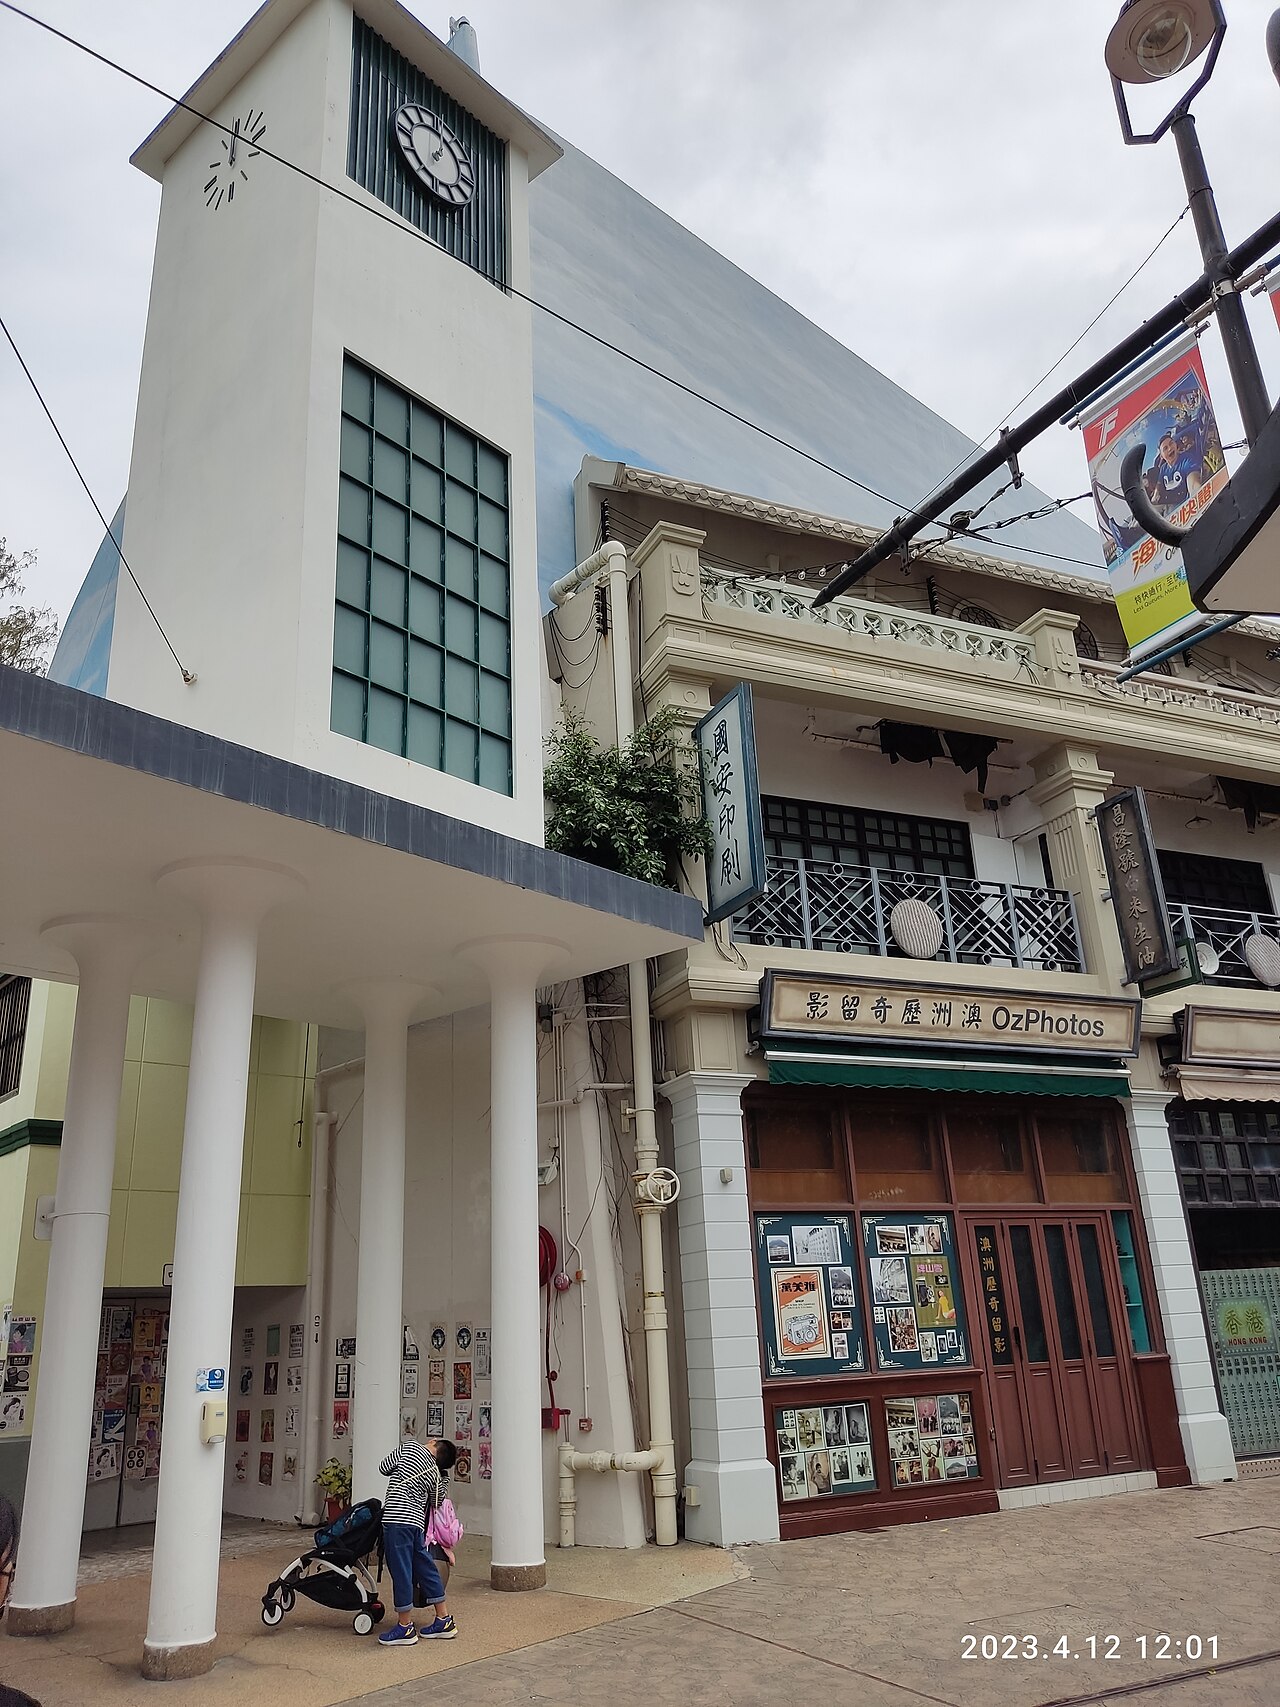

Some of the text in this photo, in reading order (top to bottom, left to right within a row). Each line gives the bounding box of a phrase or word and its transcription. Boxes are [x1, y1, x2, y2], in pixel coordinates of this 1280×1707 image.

[712, 718, 742, 887] 國安印刷
[991, 1005, 1106, 1038] OzPhotos
[1225, 1308, 1265, 1336] 香港
[1228, 1336, 1268, 1346] HONG KONG
